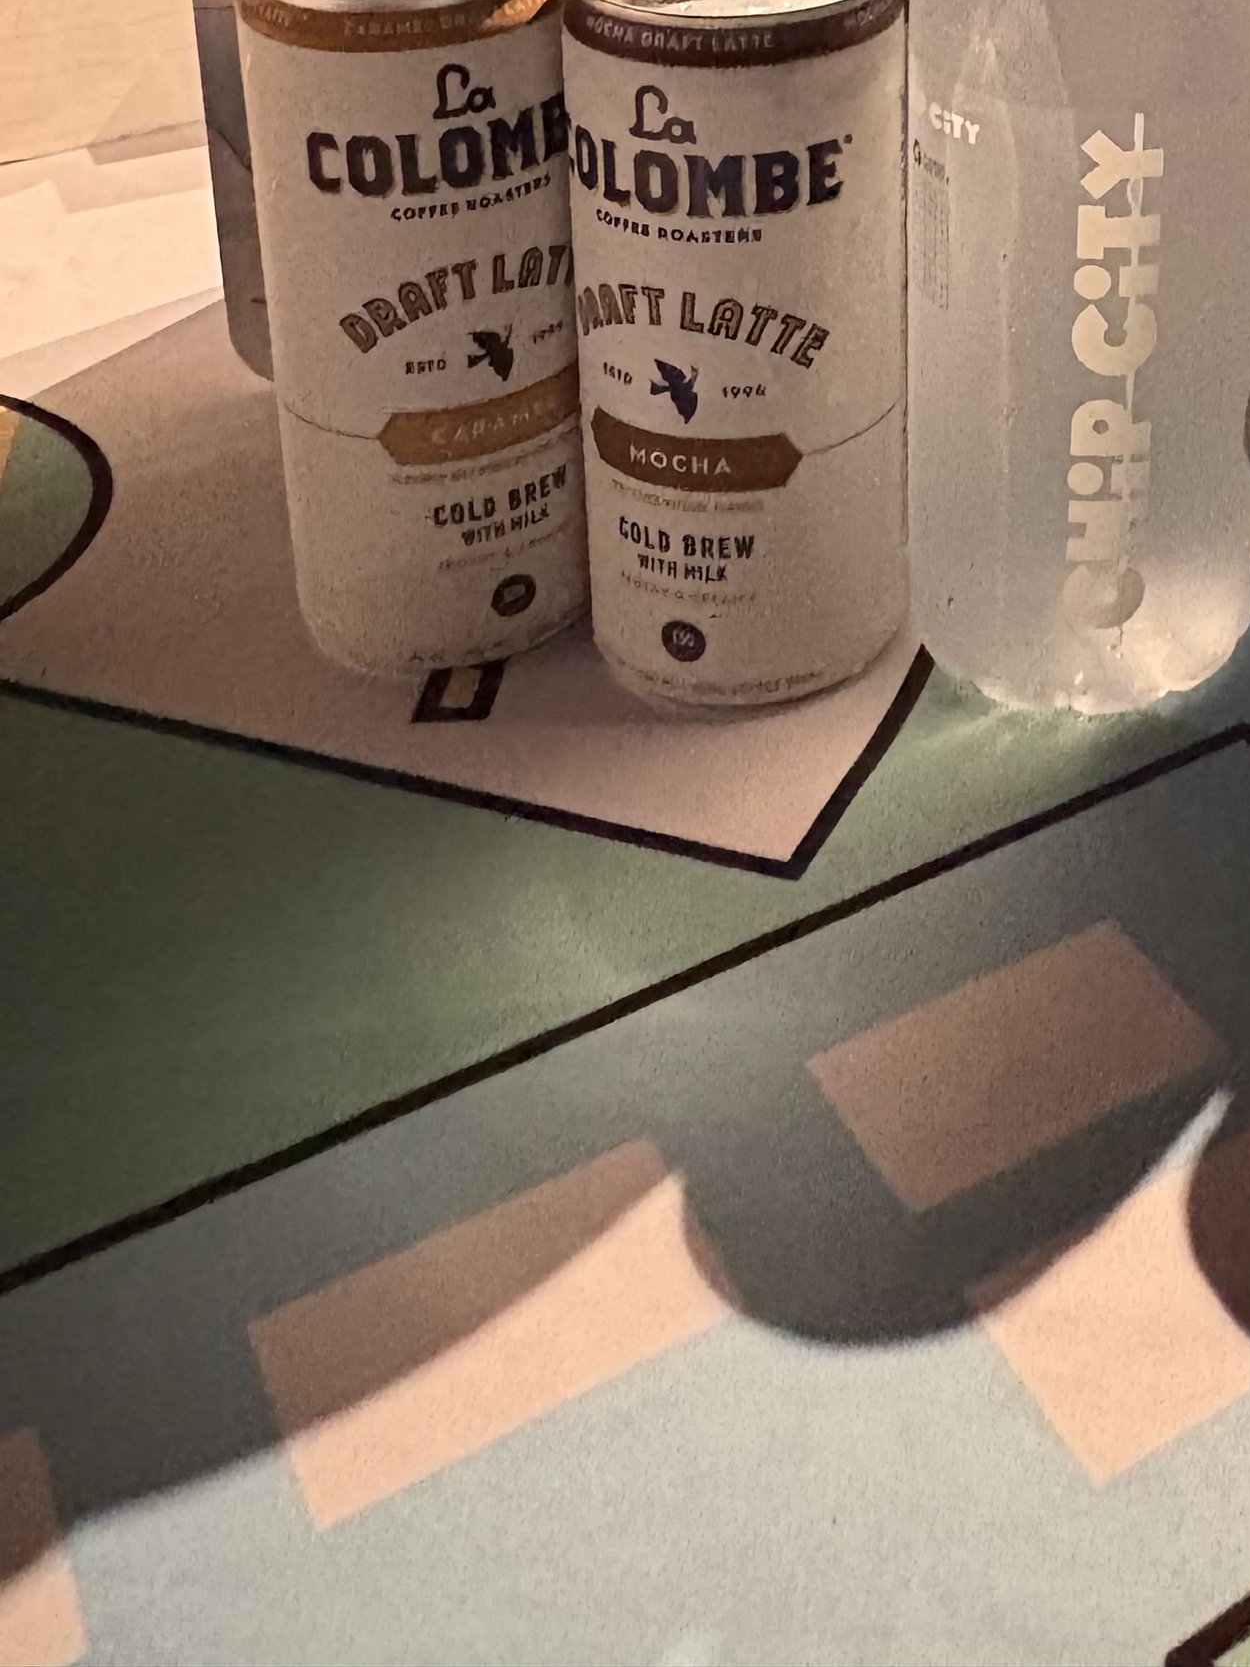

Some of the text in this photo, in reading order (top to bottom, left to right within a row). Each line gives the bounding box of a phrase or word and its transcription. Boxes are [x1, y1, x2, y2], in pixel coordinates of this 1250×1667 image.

[432, 62, 496, 120] La
[628, 84, 698, 146] La
[390, 172, 552, 223] COFFEE ROASTERS
[568, 123, 846, 218] OLOMBE
[596, 207, 764, 244] COFFEE ROASTERS
[338, 257, 477, 355] DRAFT
[679, 289, 830, 370] LATTE
[629, 443, 733, 476] MOCHA
[431, 495, 497, 528] COLD
[507, 462, 568, 511] BREW
[460, 501, 552, 548] WITH MILK
[618, 515, 755, 560] COLD BREW
[637, 552, 729, 585] WITH MILK
